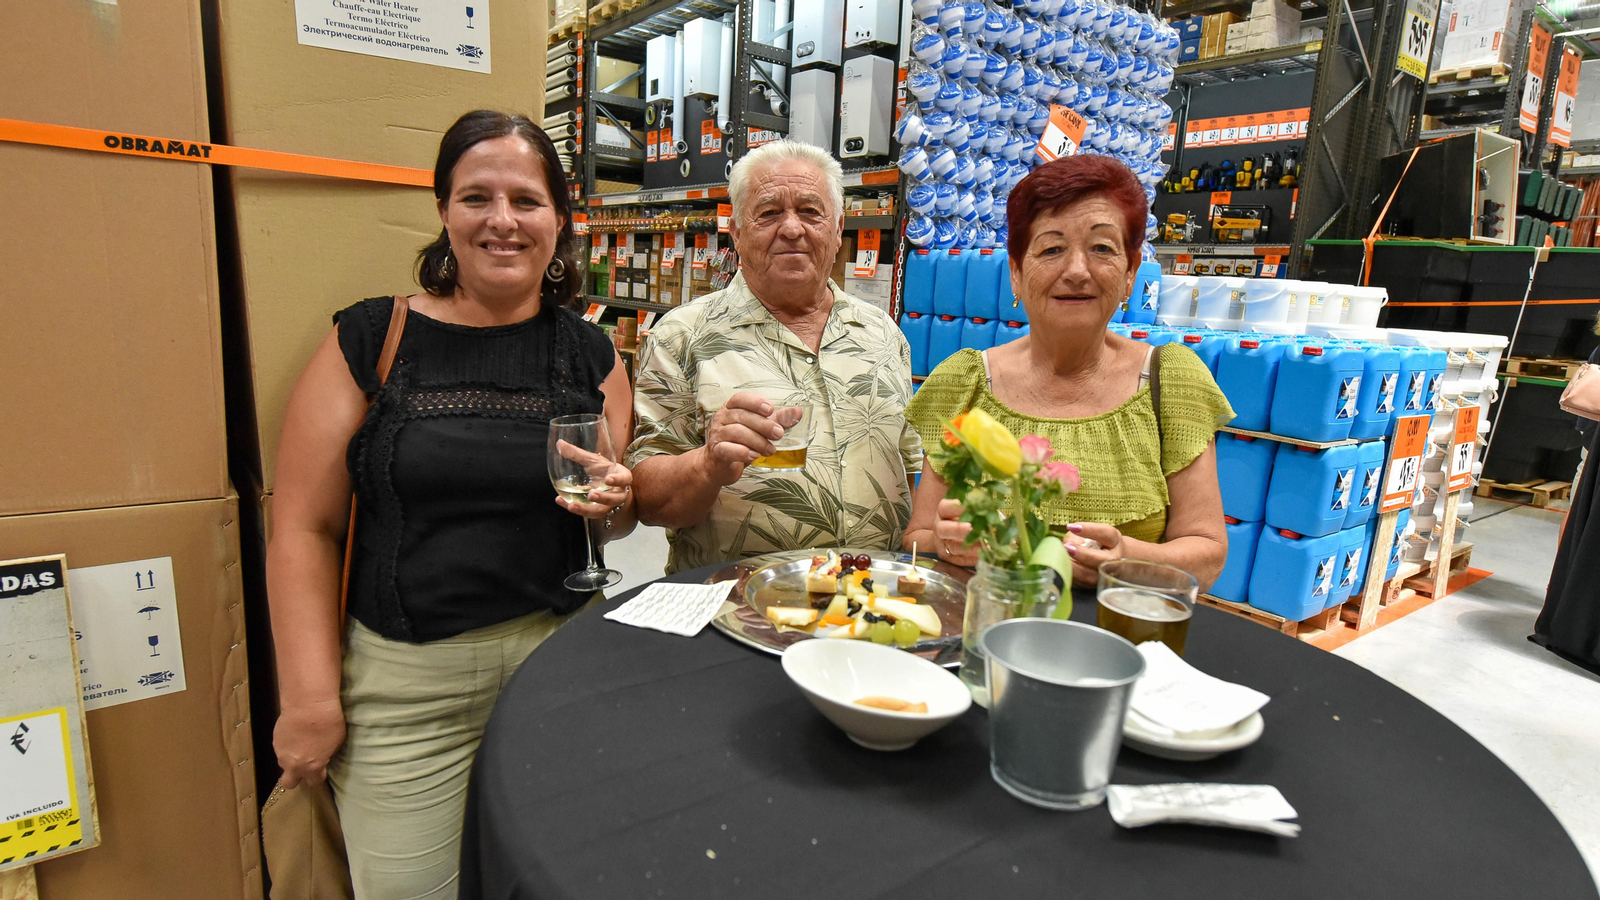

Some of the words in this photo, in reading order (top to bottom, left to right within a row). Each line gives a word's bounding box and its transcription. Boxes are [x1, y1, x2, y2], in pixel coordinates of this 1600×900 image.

[332, 0, 381, 15] Chauffe-eau
[383, 9, 421, 23] Electrique
[393, 1, 419, 13] Heater
[323, 17, 396, 37] Termoacumulador
[398, 31, 431, 43] Eléctrico
[347, 12, 373, 24] Termo
[375, 17, 409, 30] Eléctrico
[302, 24, 373, 43] Электрический
[375, 37, 449, 56] водонагреватель
[104, 135, 212, 158] OBRAMAT
[0, 571, 56, 592] DAS
[6, 813, 21, 821] IVA
[23, 799, 64, 816] INCLUIDO
